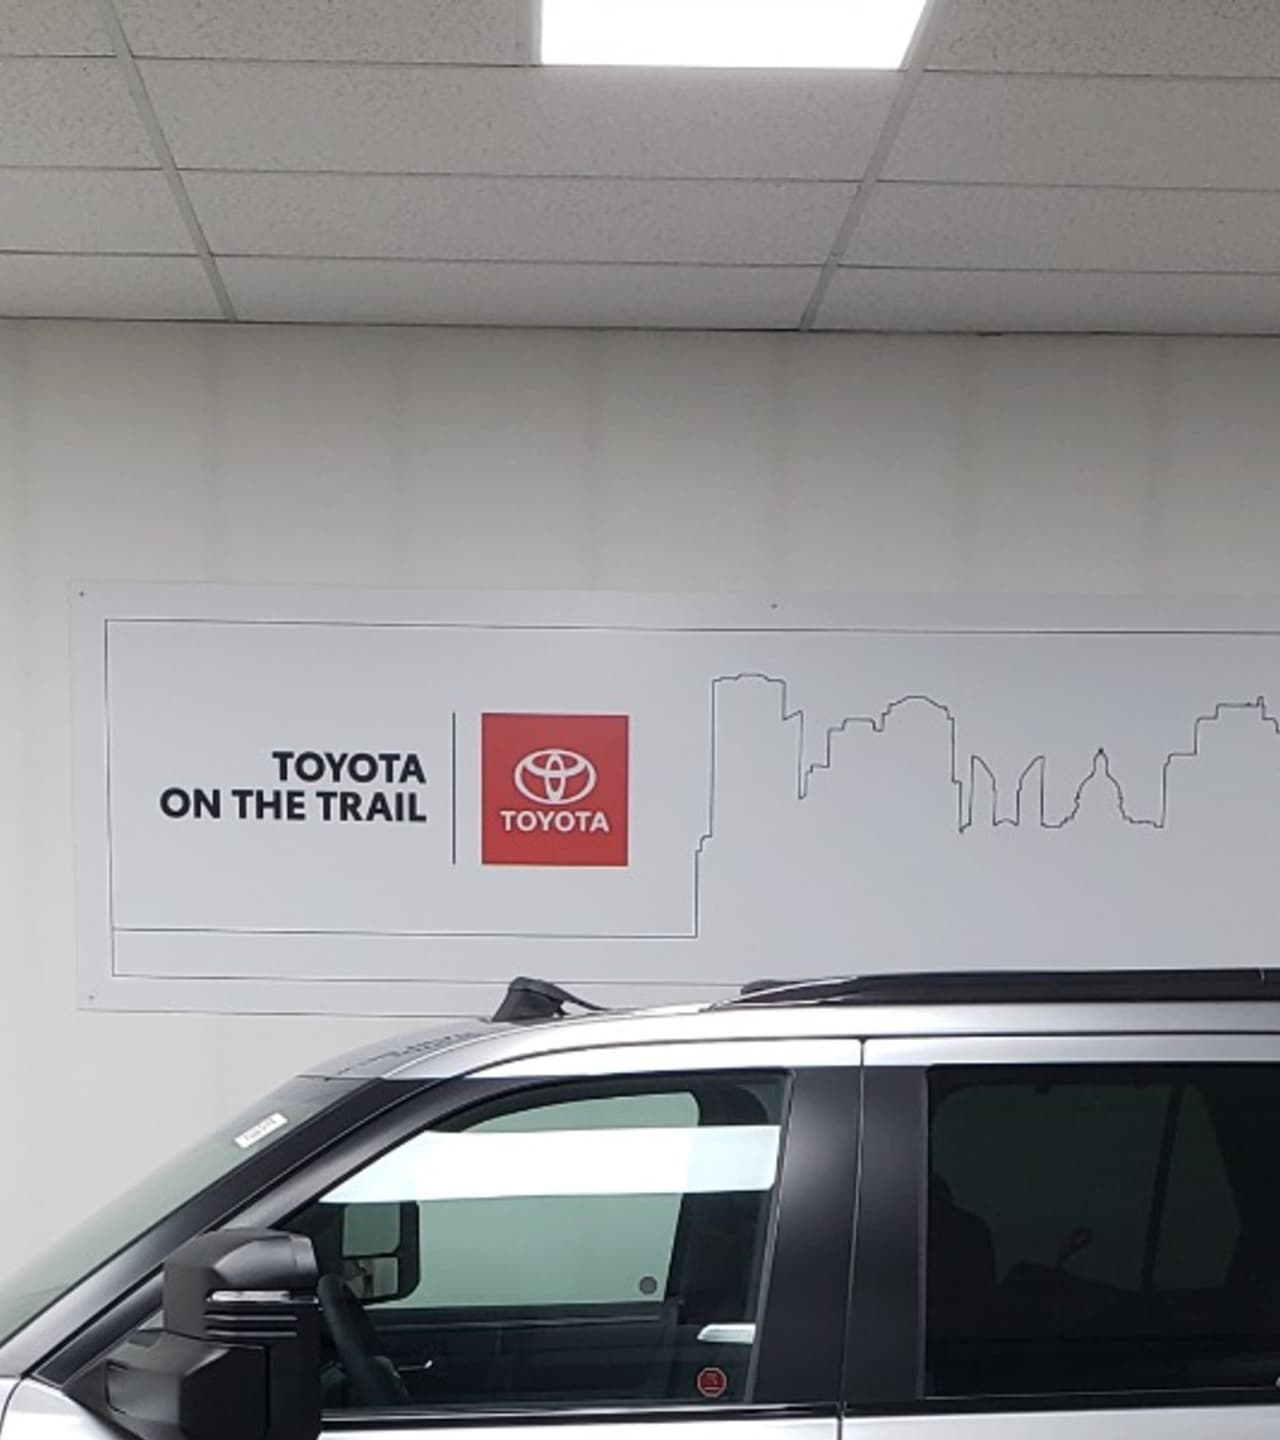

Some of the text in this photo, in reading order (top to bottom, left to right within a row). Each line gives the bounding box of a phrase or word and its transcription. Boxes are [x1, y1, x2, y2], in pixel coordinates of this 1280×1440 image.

[272, 751, 427, 784] TOYOTA
[159, 787, 427, 822] ON THE TRAIL
[500, 810, 609, 832] TOYOTA
